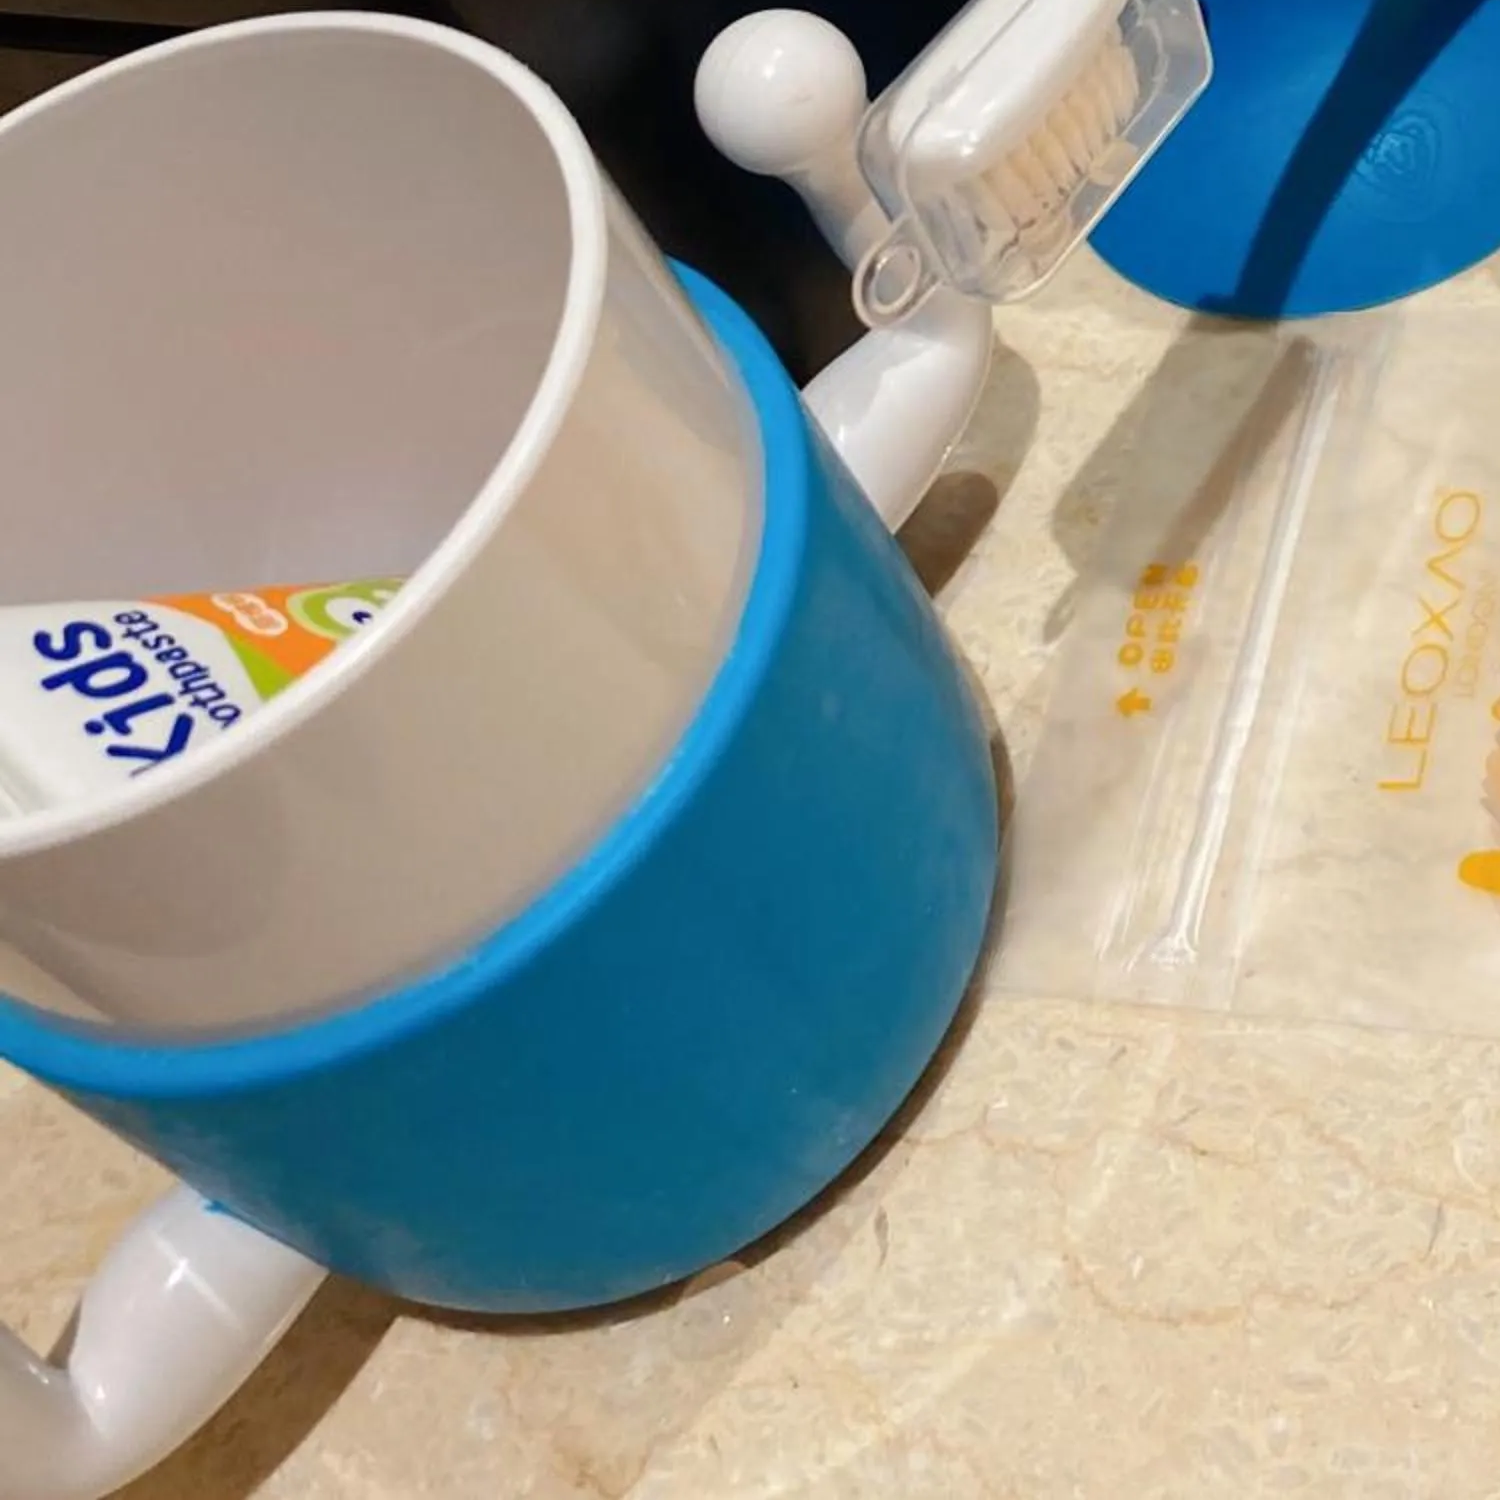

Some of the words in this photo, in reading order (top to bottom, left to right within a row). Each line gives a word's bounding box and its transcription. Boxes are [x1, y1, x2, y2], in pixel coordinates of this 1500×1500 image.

[33, 620, 194, 778] Kids
[114, 609, 242, 729] othpaste
[1377, 492, 1481, 791] LEOXAO
